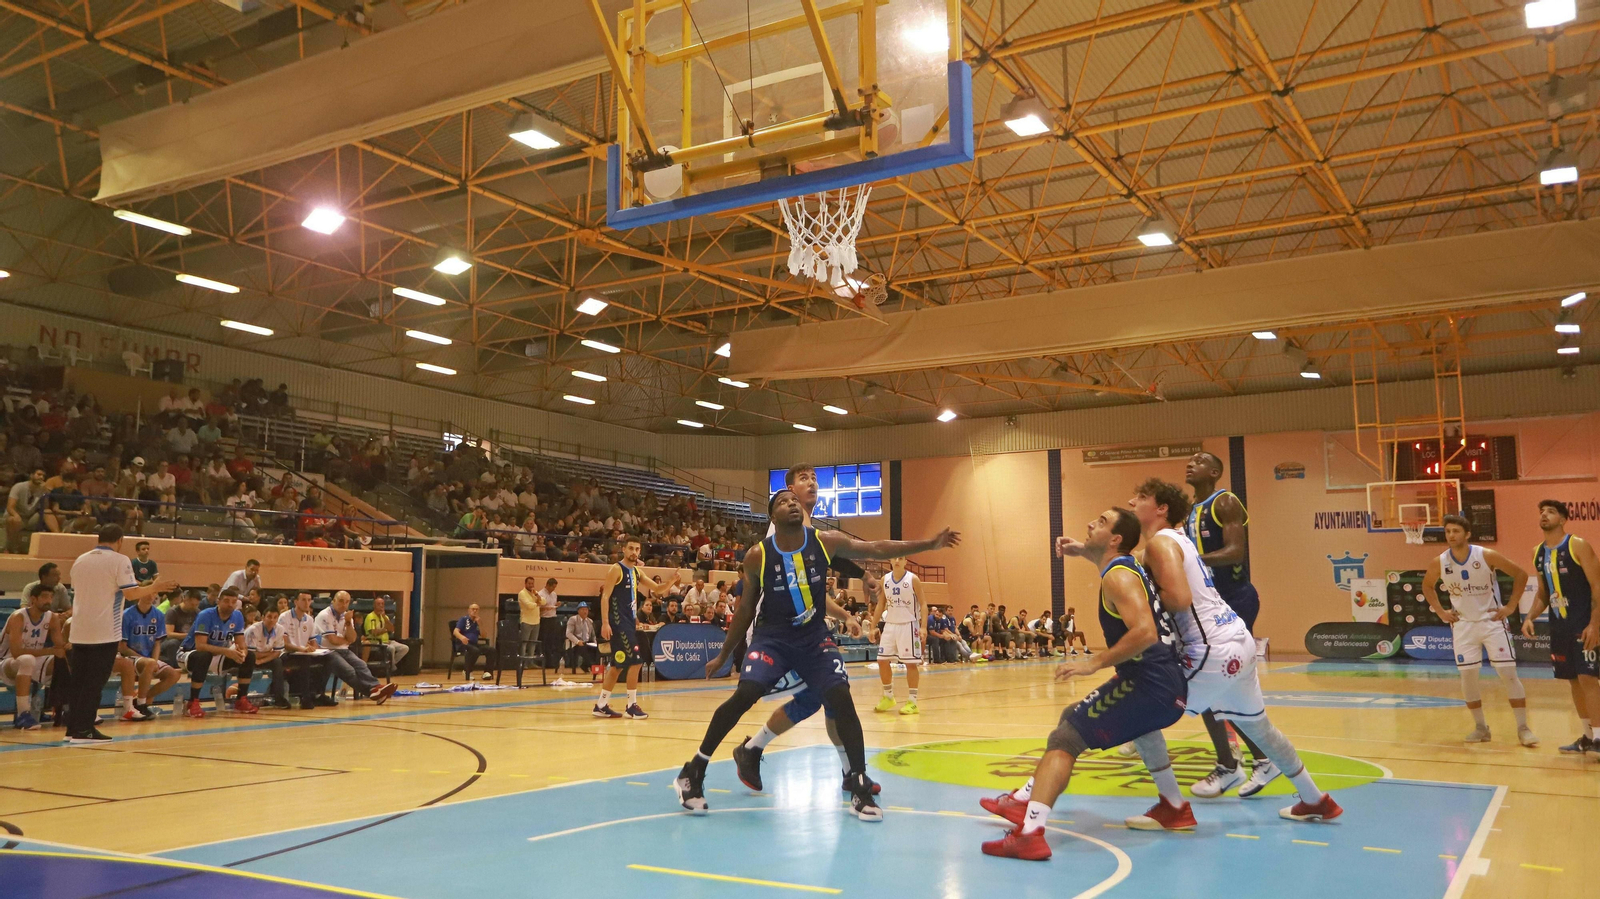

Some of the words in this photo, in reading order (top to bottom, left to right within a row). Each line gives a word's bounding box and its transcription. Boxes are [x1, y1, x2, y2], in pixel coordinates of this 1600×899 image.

[39, 324, 81, 348] NO
[300, 554, 333, 562] PRENSA
[787, 570, 807, 588] 24
[892, 587, 900, 596] 13
[30, 628, 40, 638] 14
[132, 624, 157, 636] ULB
[1312, 632, 1348, 640] Federación
[675, 640, 705, 651] Diputación
[676, 653, 684, 662] de
[684, 652, 700, 662] Cádiz
[1582, 650, 1596, 662] 10
